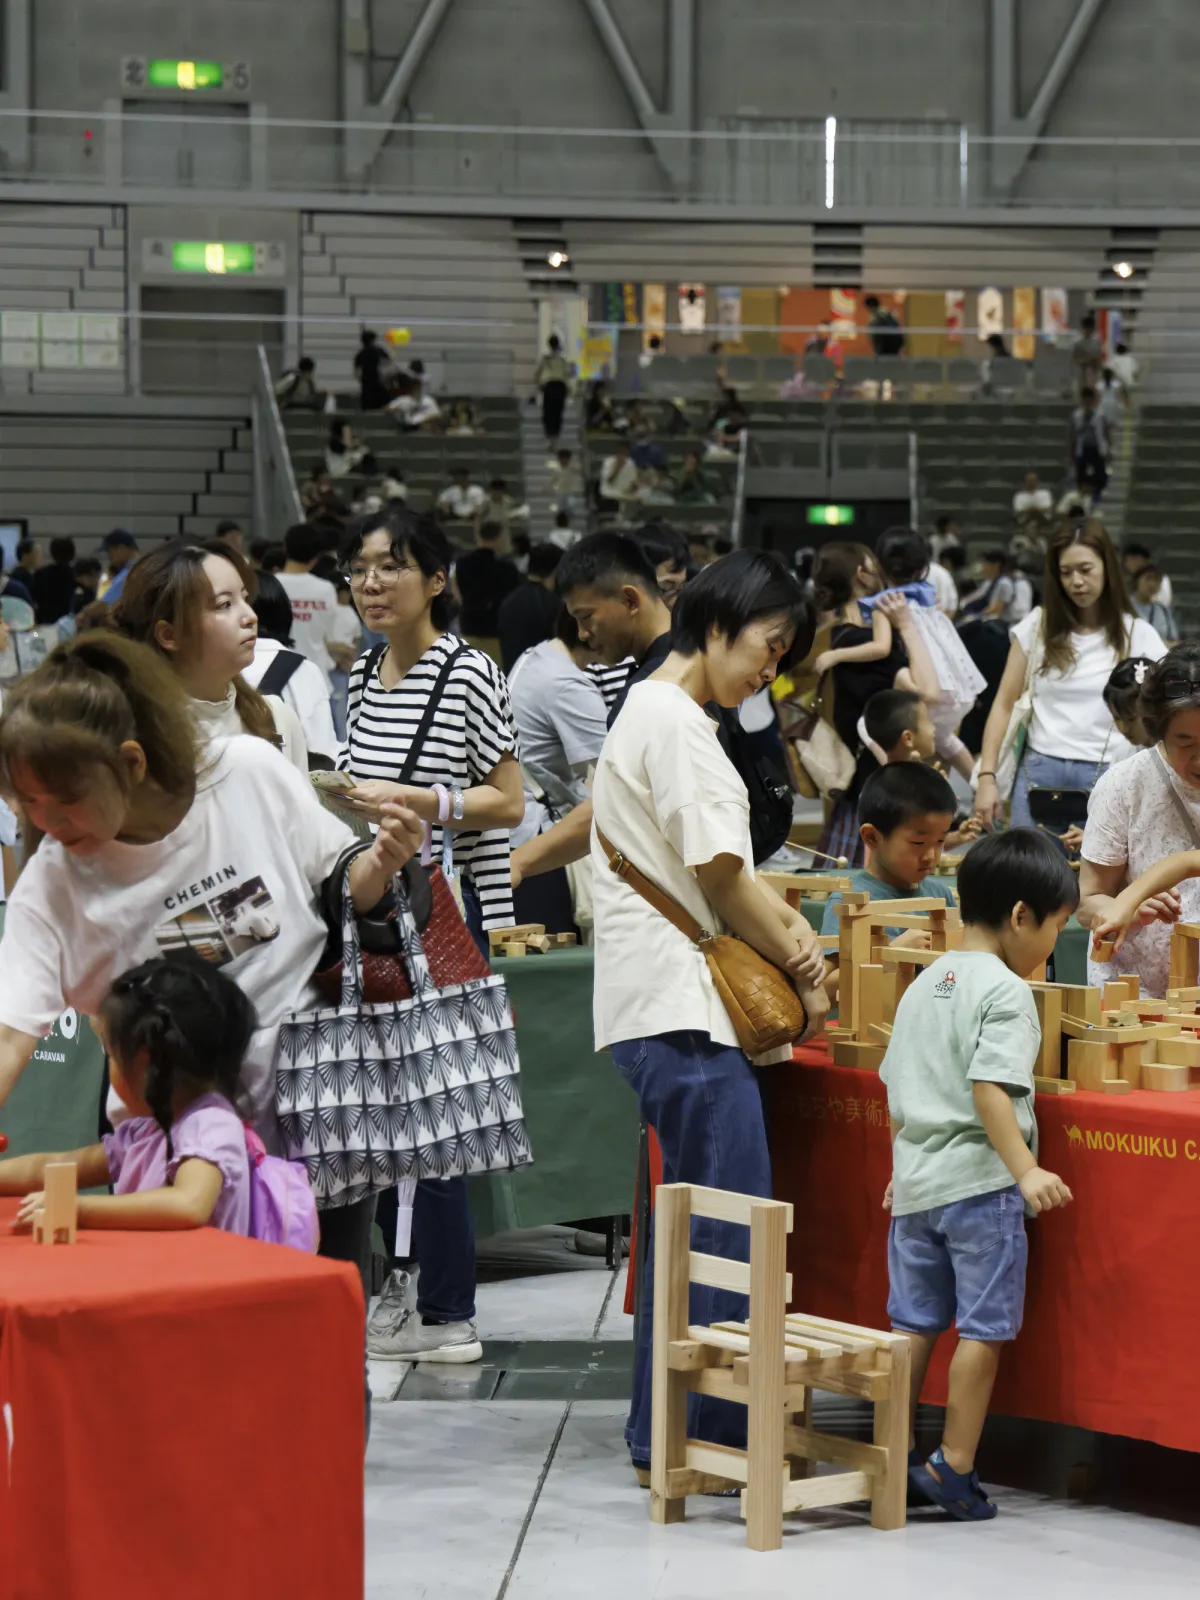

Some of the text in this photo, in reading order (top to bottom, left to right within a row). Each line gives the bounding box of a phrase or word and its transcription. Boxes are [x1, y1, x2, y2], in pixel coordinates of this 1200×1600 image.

[164, 865, 238, 910] CHEMIN
[34, 1049, 66, 1063] CARAVAN
[1086, 1130, 1177, 1158] MOKUIKU
